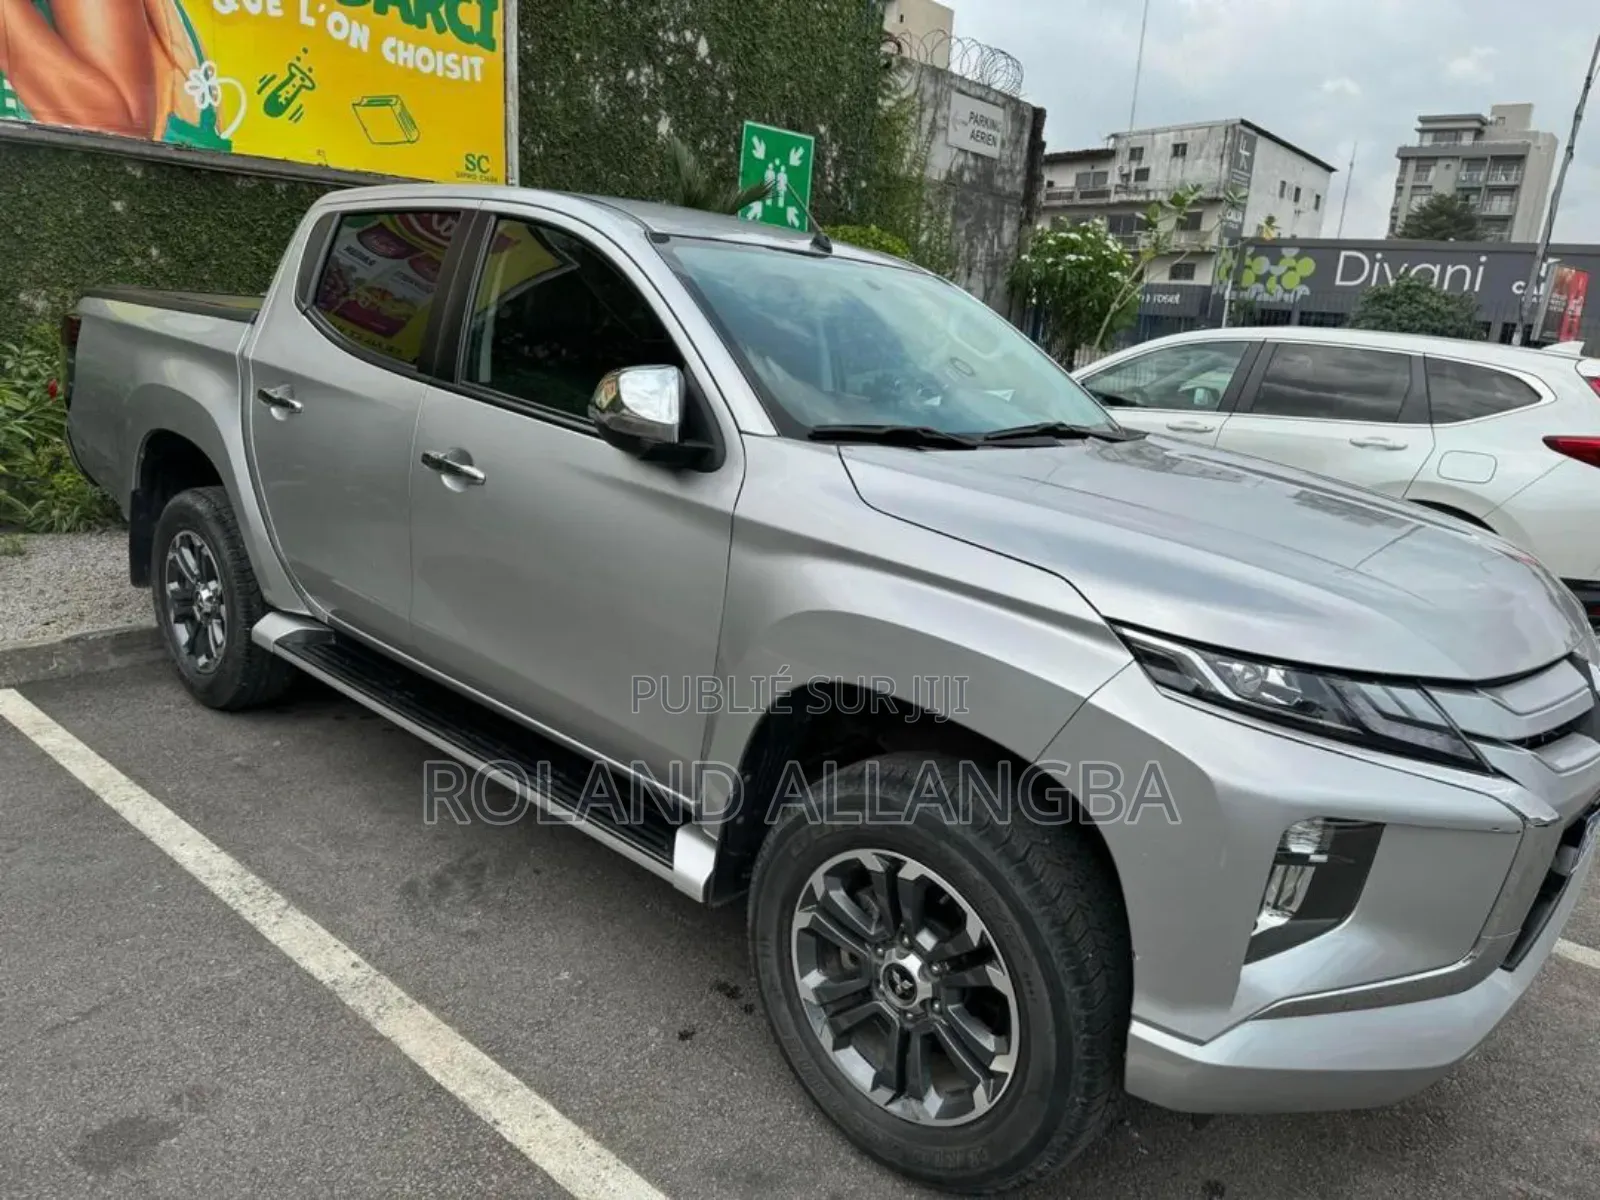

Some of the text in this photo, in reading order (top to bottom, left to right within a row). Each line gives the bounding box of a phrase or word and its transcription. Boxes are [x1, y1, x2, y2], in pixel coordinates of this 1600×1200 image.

[300, 0, 370, 52] L'ON
[381, 36, 485, 82] CHOISIT
[465, 153, 490, 173] SC
[1335, 250, 1487, 292] Divani
